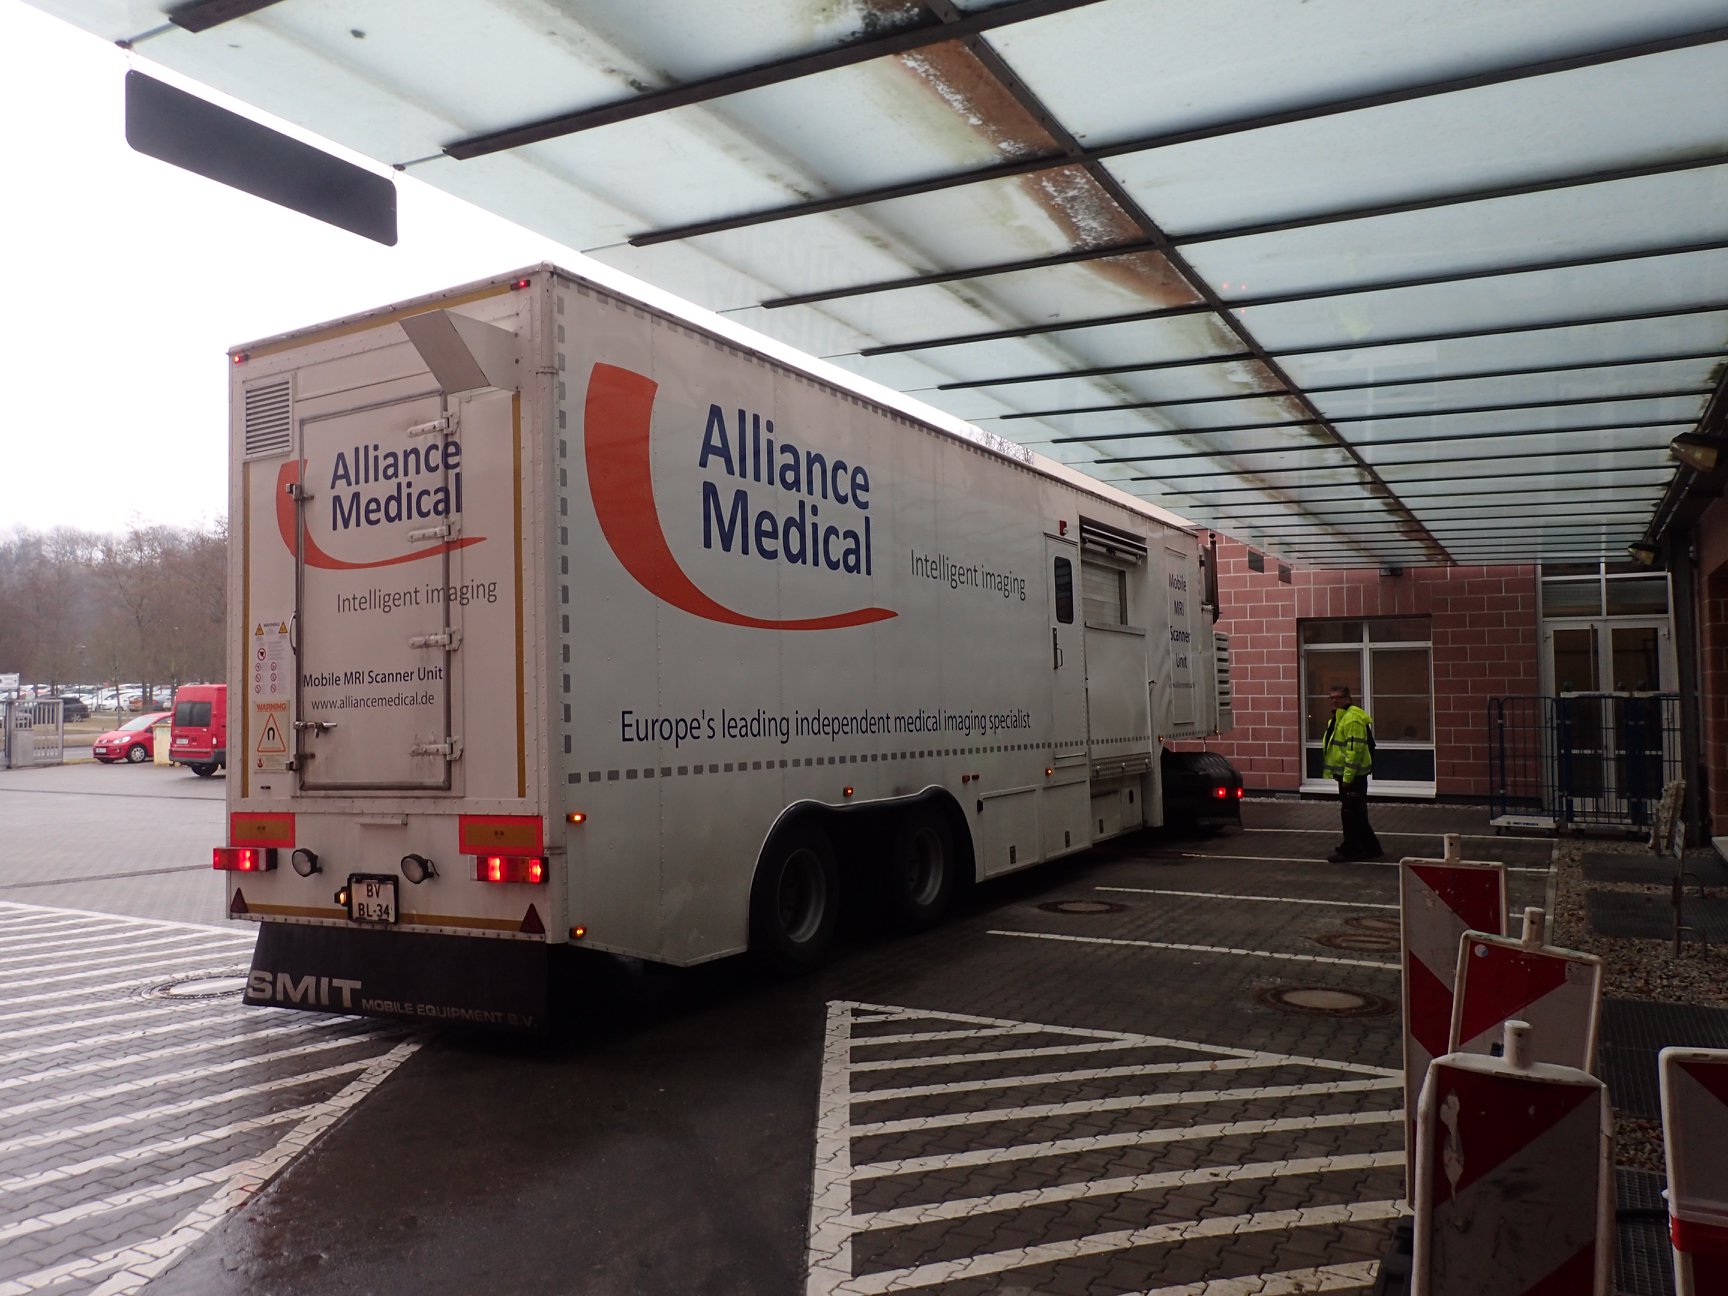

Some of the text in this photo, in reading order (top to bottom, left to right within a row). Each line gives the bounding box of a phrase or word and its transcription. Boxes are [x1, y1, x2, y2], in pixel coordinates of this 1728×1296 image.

[330, 440, 462, 490] Alliance
[699, 403, 870, 510] Alliance
[332, 472, 462, 531] Medical
[702, 480, 872, 576] Medical
[910, 549, 1026, 601] Intelligent imaging
[1168, 572, 1187, 592] Mobile
[336, 579, 498, 614] Intelligent imaging
[1173, 600, 1184, 616] MRI
[1169, 625, 1190, 643] Scanner
[1175, 652, 1188, 669] Unit
[303, 671, 341, 688] Mobile
[344, 671, 365, 686] MRI
[368, 669, 414, 685] Scanner
[418, 666, 443, 682] Unit
[256, 703, 287, 711] WARNING
[311, 691, 435, 711] www.alliancemedical.de
[621, 708, 1031, 748] Europe's leading independent medical imaging specialist
[366, 884, 381, 898] BV
[358, 903, 390, 918] BL-34
[246, 969, 362, 1009] SMIT
[361, 998, 414, 1015] MOBILE
[416, 1003, 505, 1024] EQUIPMENT
